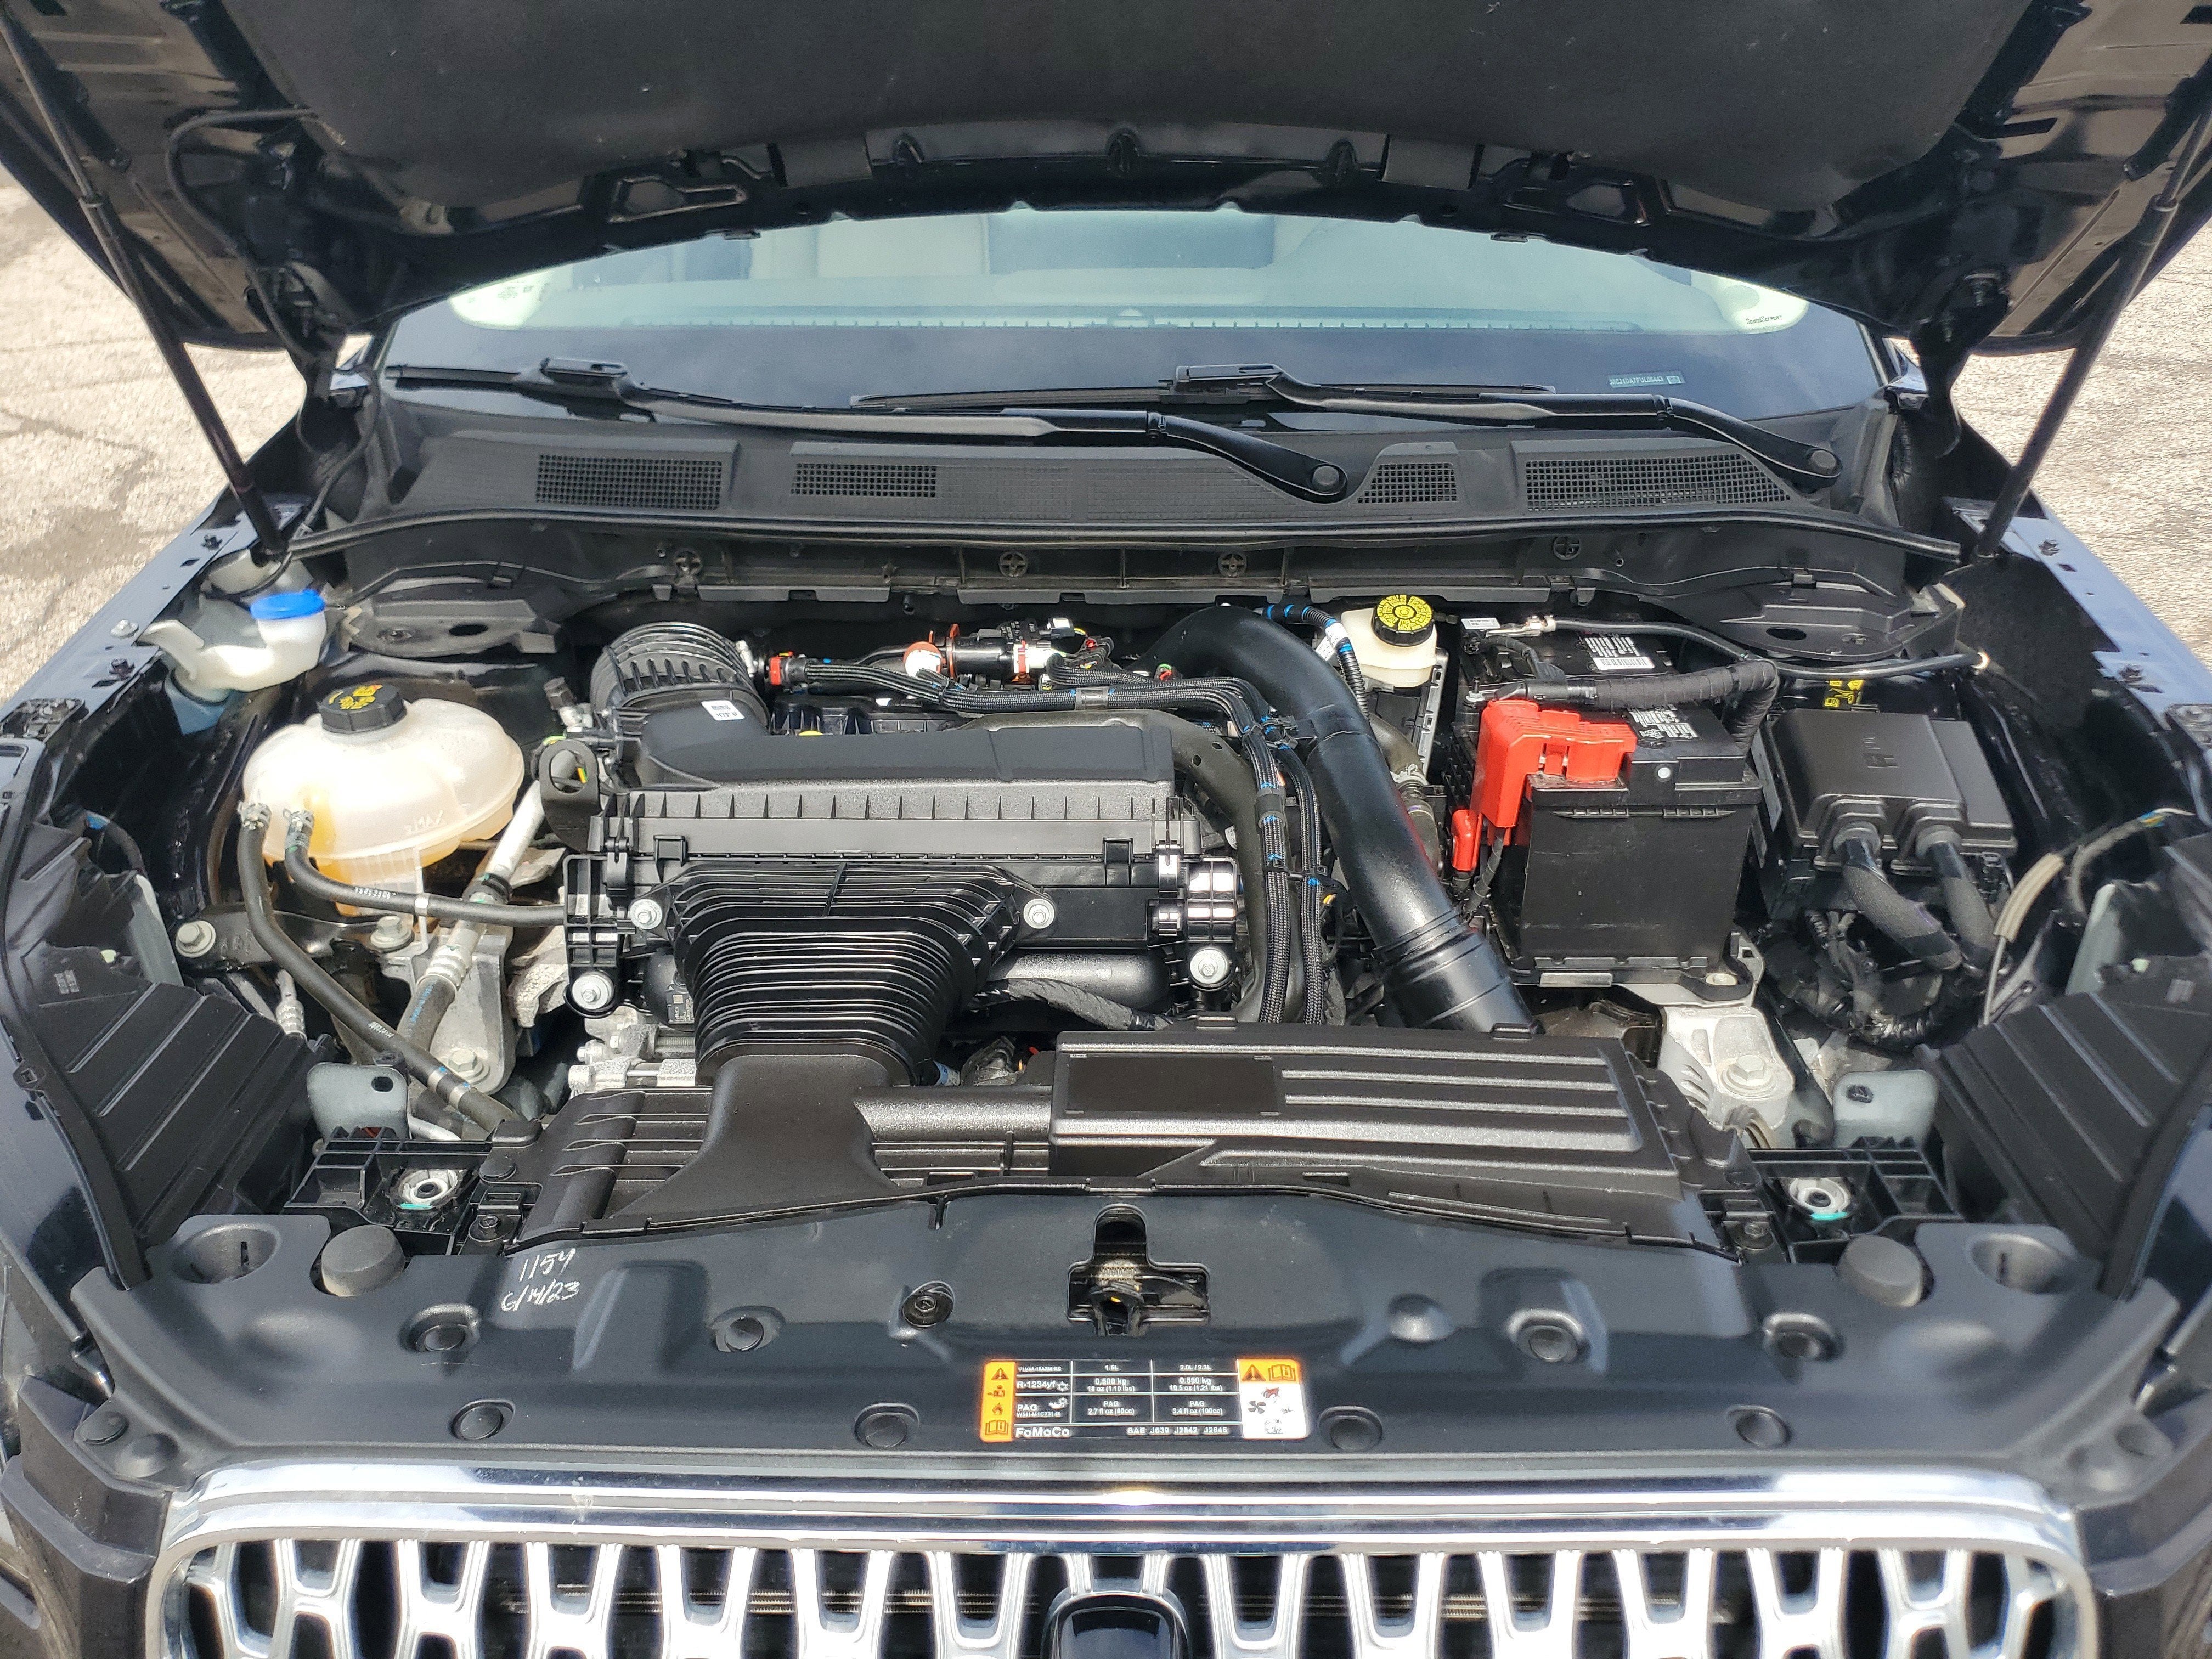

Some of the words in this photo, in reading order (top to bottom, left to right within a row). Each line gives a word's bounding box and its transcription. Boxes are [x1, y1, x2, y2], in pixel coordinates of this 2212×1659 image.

[1017, 1380, 1056, 1389] R-1234yf
[1117, 1378, 1127, 1386] kg
[1201, 1376, 1211, 1385] kg
[1015, 1427, 1070, 1437] FoMoCo
